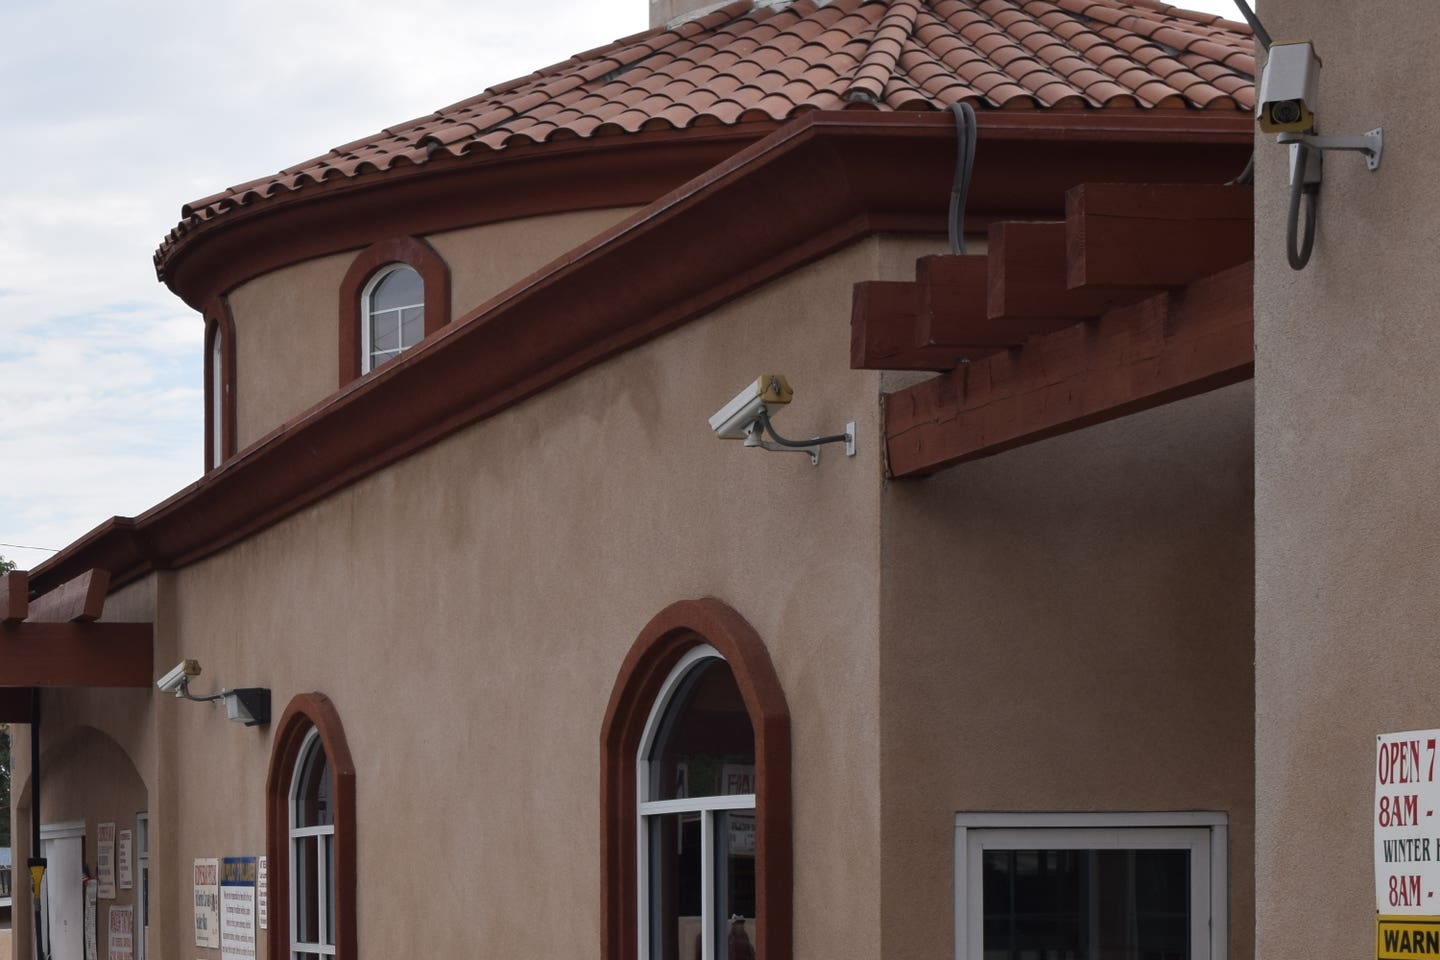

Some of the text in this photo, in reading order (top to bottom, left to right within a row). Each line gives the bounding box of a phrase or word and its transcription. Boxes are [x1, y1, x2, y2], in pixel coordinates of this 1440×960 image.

[1378, 738, 1436, 785] OPEN 7
[1378, 795, 1418, 828] 8AM
[1383, 838, 1431, 863] WINTER
[1388, 875, 1422, 907] 8AM
